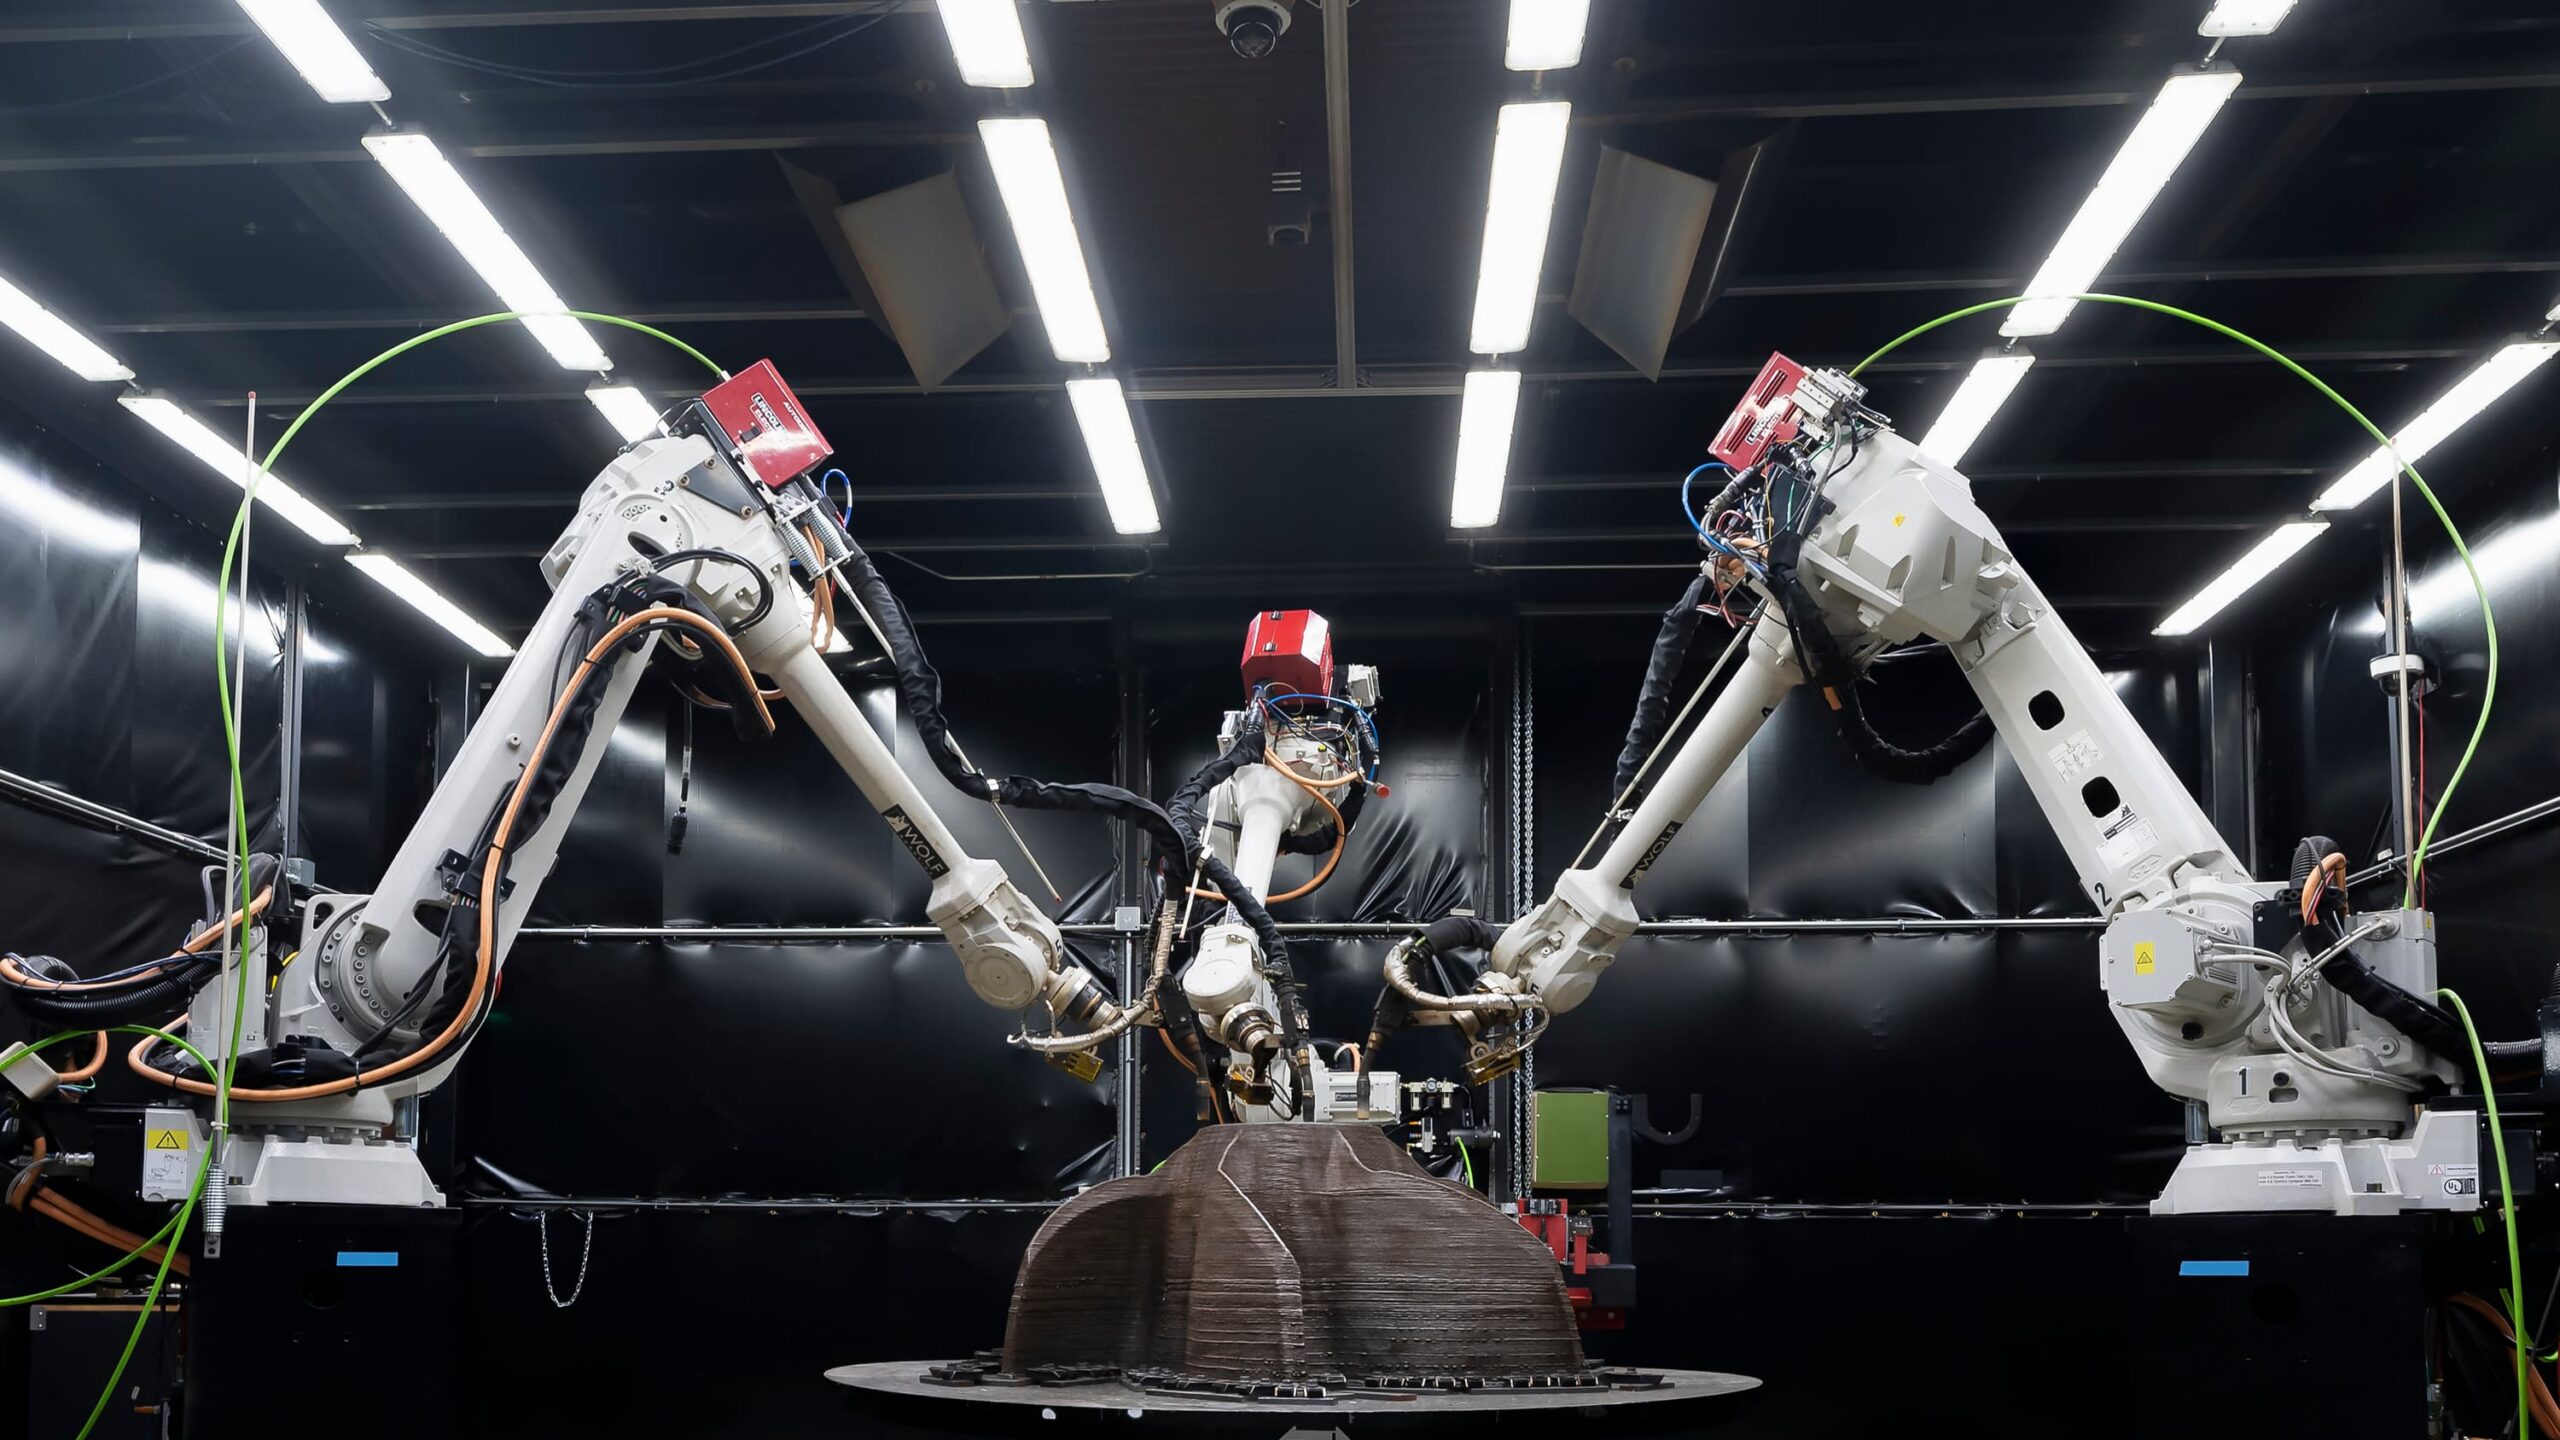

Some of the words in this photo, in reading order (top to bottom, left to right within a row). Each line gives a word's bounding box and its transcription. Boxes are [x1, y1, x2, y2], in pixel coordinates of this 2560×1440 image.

[905, 827, 944, 873] WOLF
[1637, 825, 1675, 868] WOLF
[2094, 882, 2113, 907] 2
[2238, 1068, 2247, 1096] 1
[2448, 1182, 2459, 1191] UL
